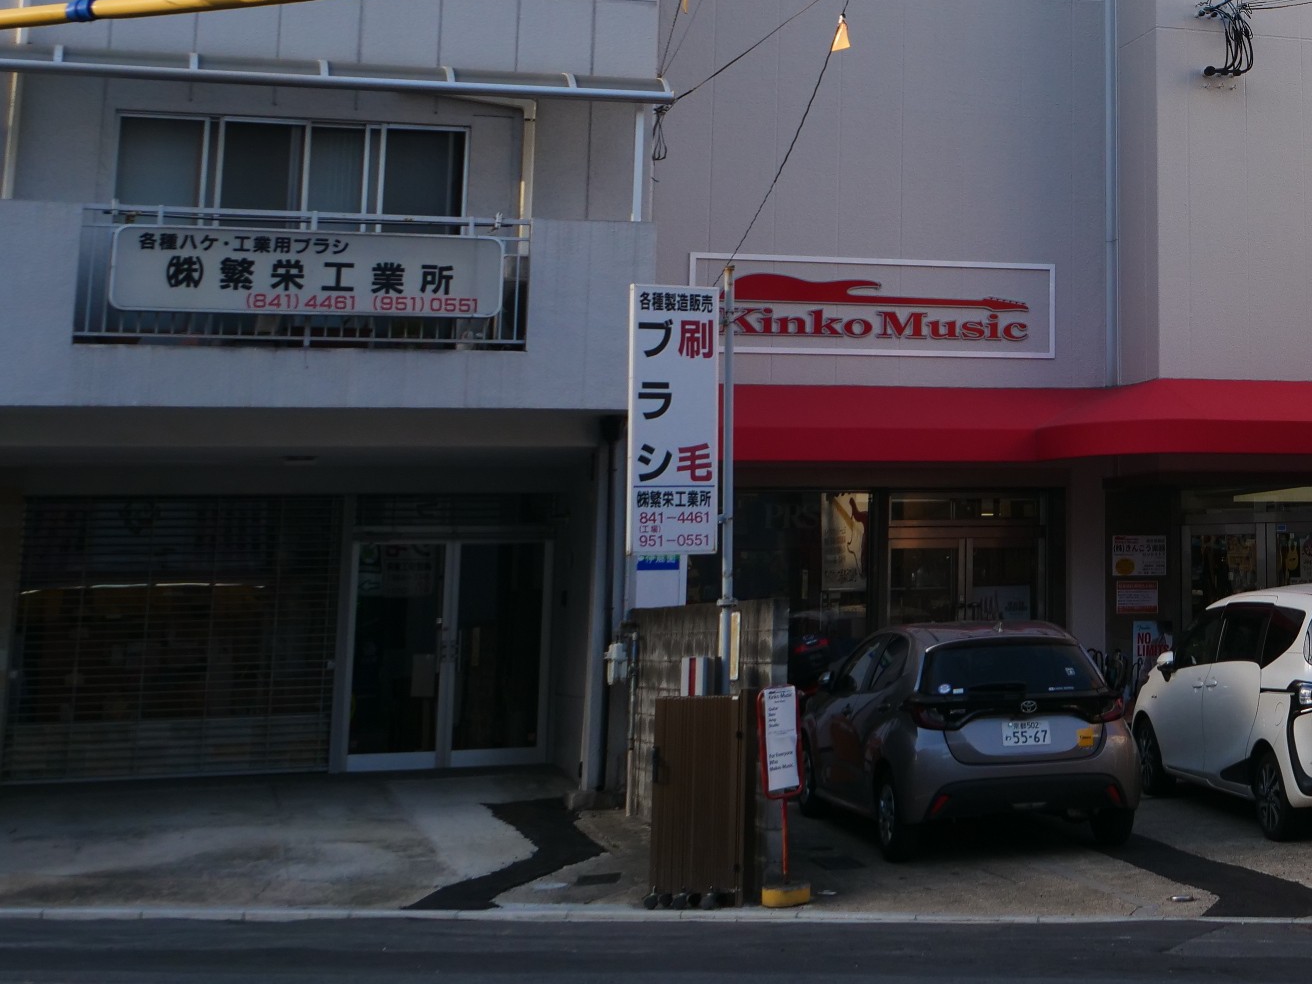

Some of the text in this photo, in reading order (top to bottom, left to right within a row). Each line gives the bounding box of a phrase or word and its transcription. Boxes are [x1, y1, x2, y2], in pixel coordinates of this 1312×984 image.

[139, 232, 349, 255] 各種ハケ・工業用ブラシ
[639, 292, 713, 313] 各種製造販売
[719, 307, 1028, 341] Kinko Music
[1137, 632, 1151, 645] NO
[1013, 729, 1047, 744] 55-67
